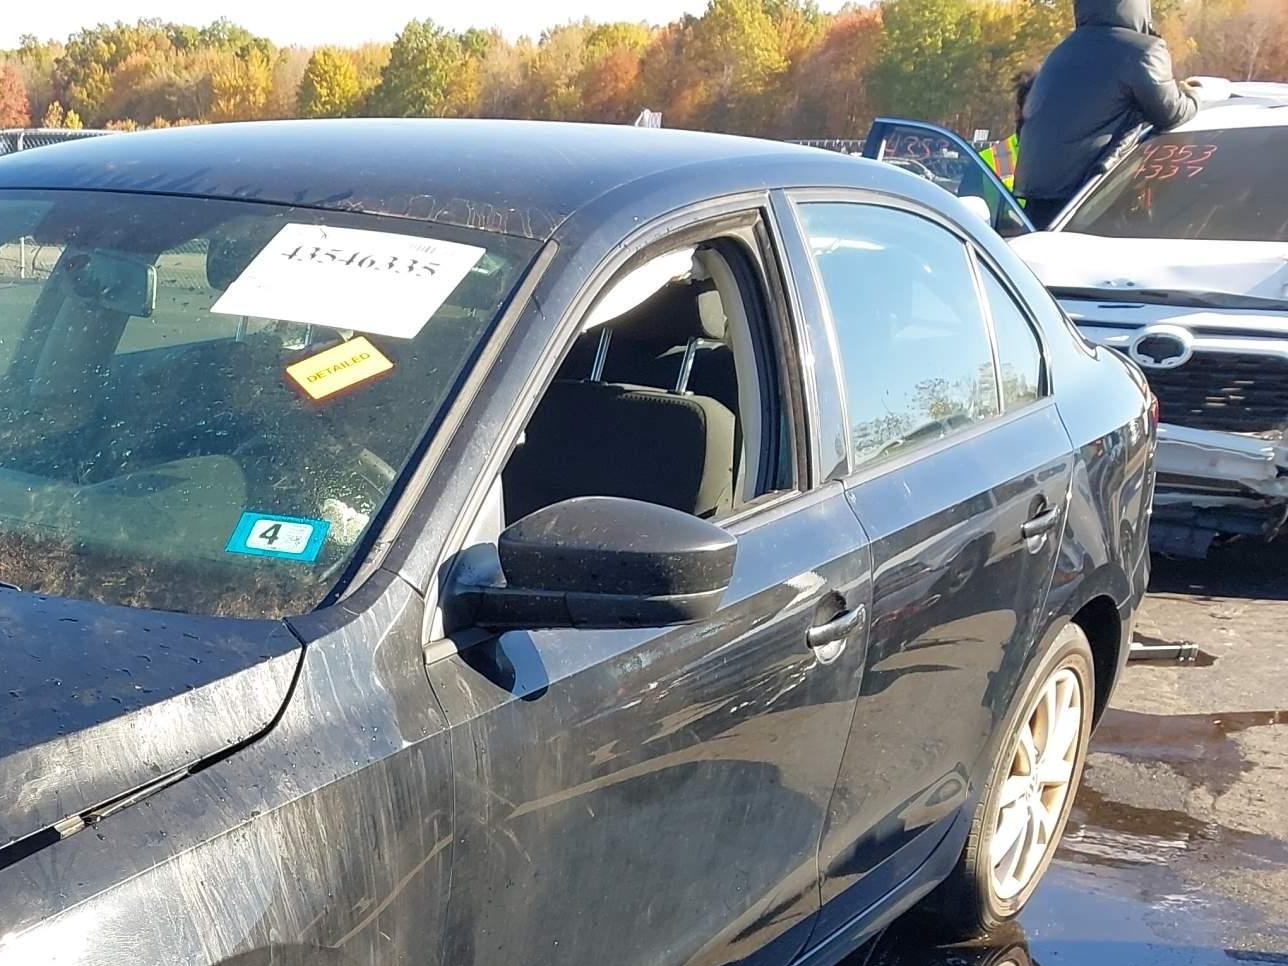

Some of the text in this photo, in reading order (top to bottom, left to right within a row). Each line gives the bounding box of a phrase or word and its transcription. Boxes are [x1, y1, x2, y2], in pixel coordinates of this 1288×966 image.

[1142, 144, 1219, 164] 4353
[280, 245, 441, 277] 43546335
[306, 352, 371, 383] DETAILED
[259, 523, 283, 545] 4
